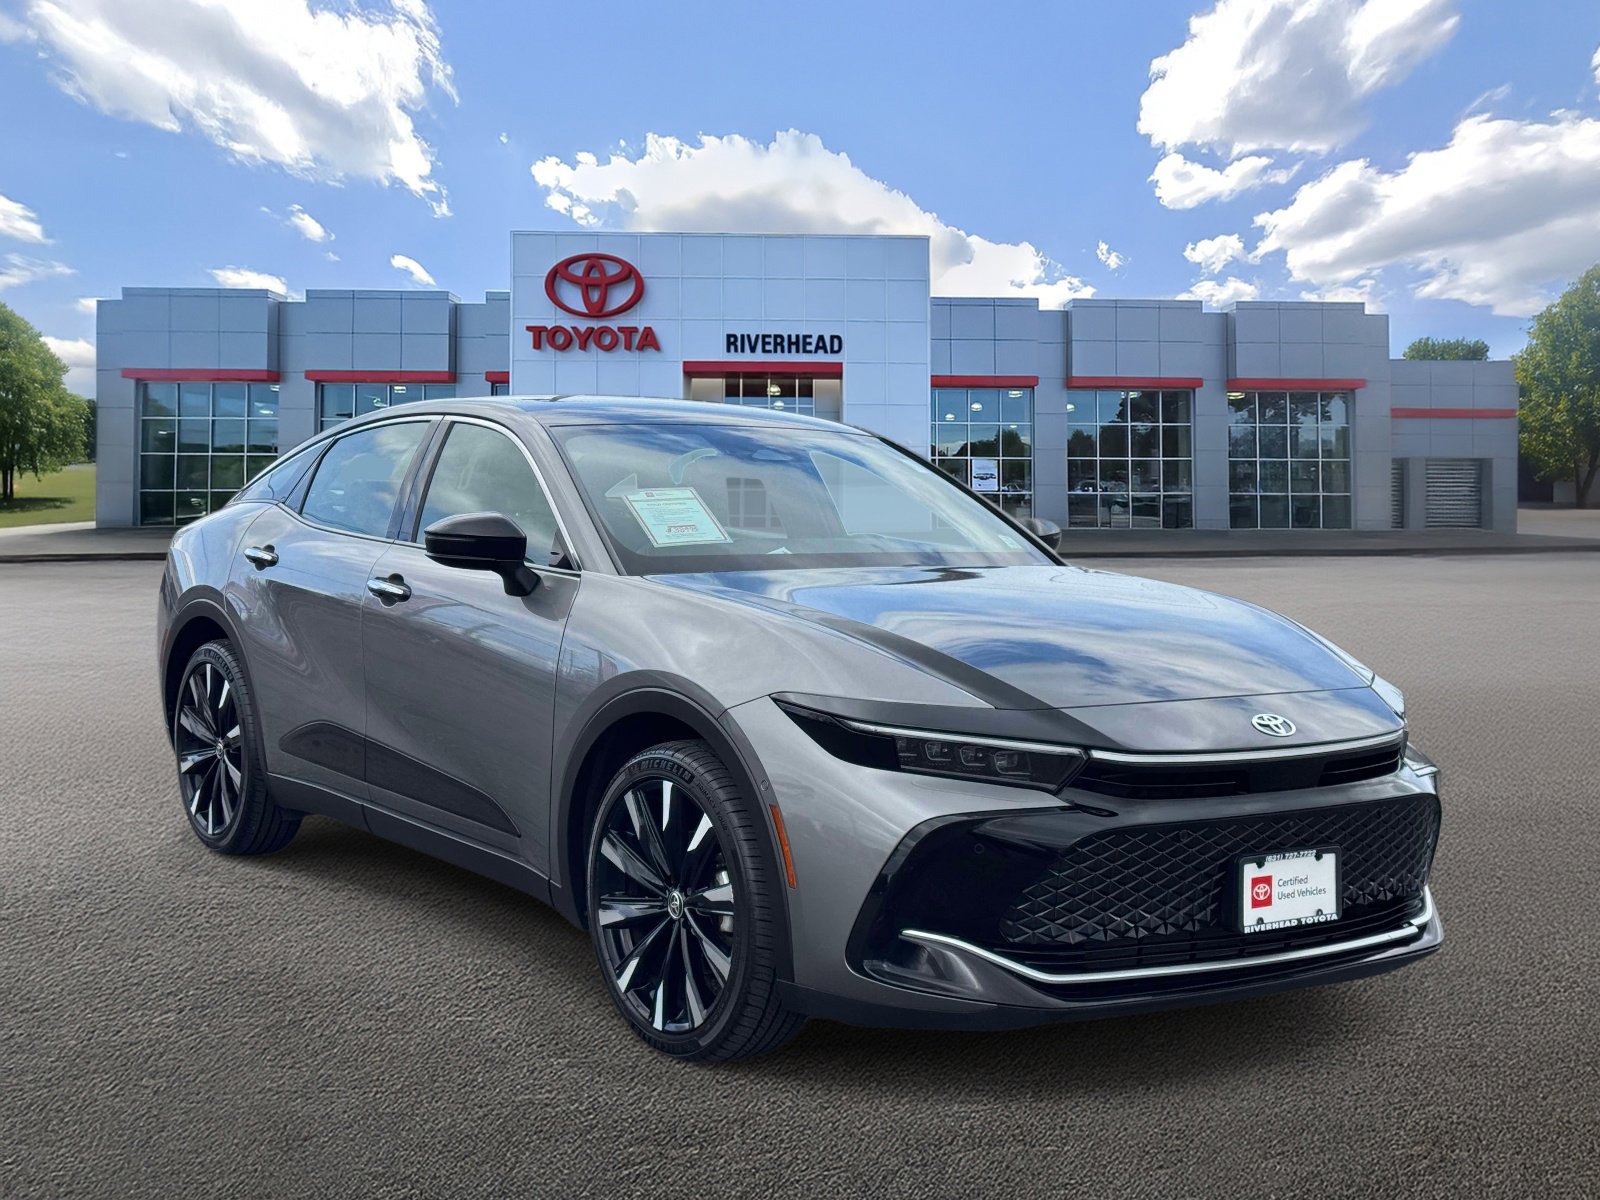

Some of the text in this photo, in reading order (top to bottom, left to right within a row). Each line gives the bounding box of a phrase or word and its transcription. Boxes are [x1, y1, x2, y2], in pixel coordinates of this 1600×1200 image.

[526, 326, 661, 351] TOYOTA
[726, 334, 843, 354] RIVERHEAD
[641, 760, 692, 781] MICHELIN
[1277, 875, 1309, 887] Certified
[1277, 886, 1327, 900] Used Vehicles
[1244, 913, 1338, 934] RIVERHEAD TOYOTA
